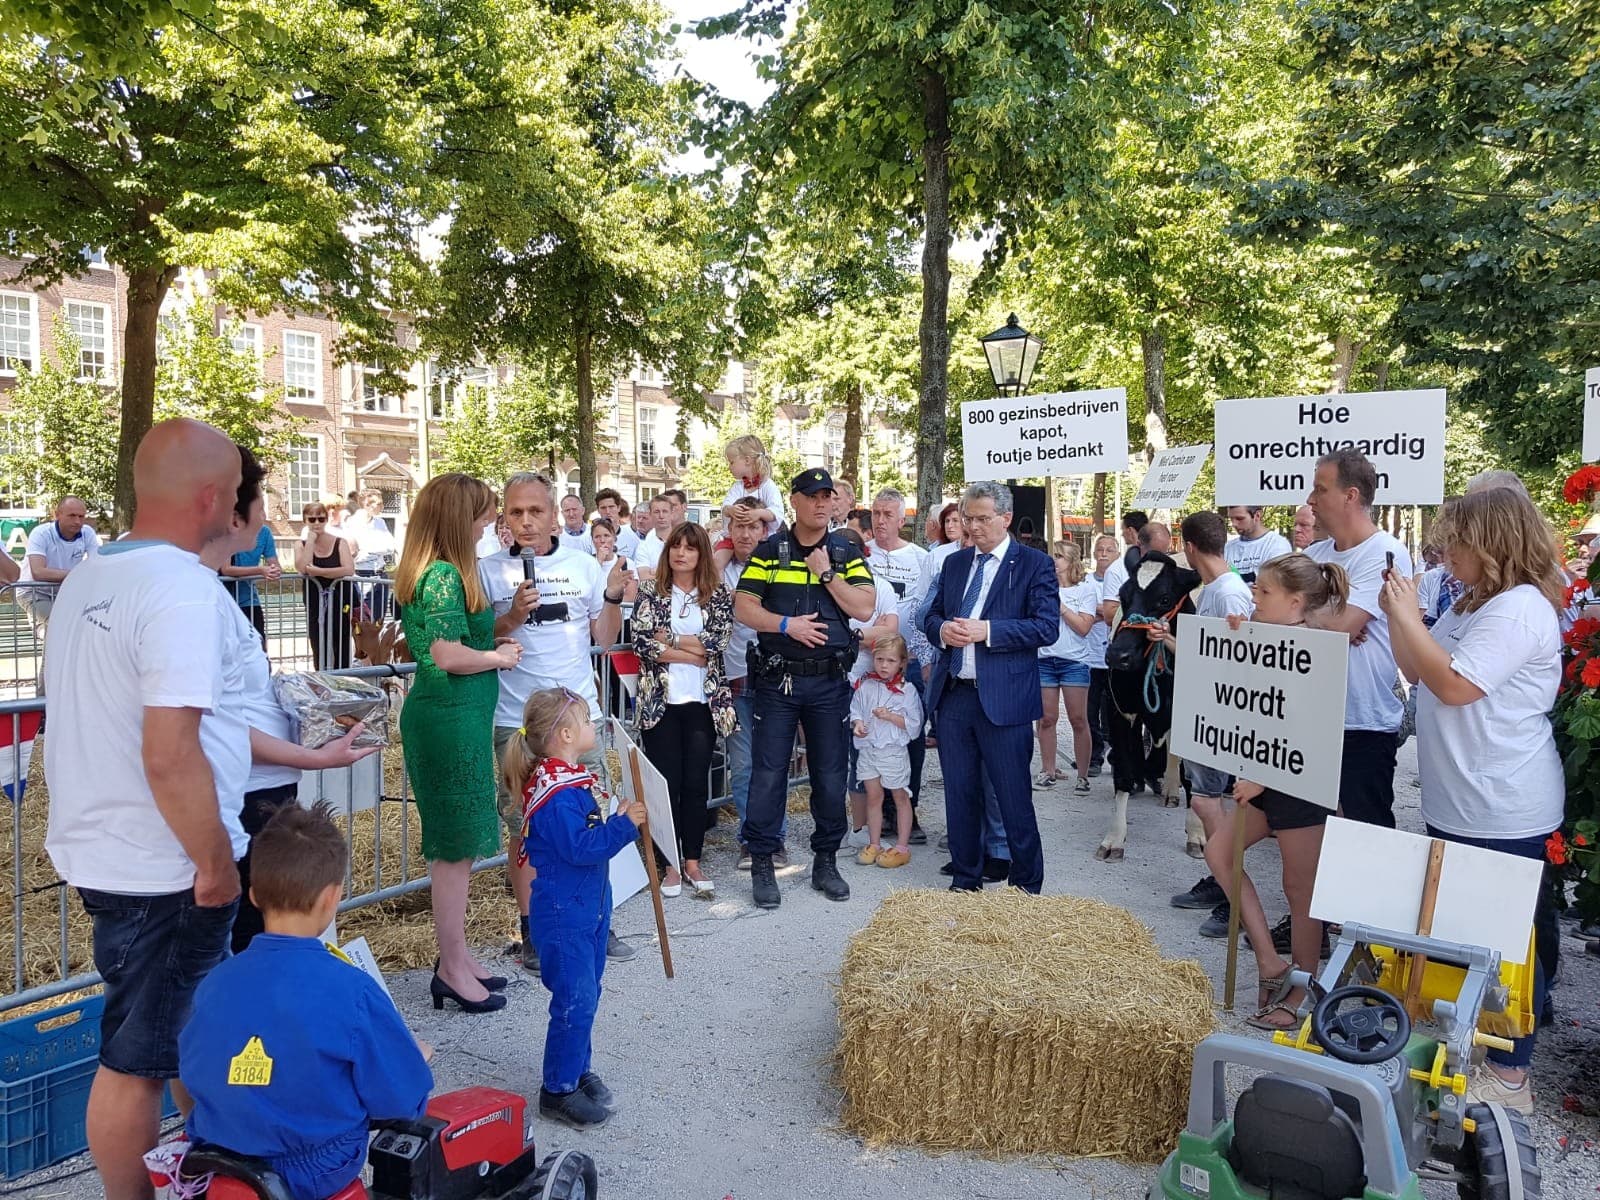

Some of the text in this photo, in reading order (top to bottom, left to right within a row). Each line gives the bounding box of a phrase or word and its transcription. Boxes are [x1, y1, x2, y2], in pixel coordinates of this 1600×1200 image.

[968, 400, 1119, 425] 800 gezinsbedrijven
[1298, 402, 1351, 425] Hoe
[1020, 424, 1067, 442] kapot,
[986, 442, 1104, 465] foutje bedankt
[1229, 432, 1426, 461] onrechtvaardig
[1259, 470, 1305, 491] kun
[1199, 627, 1312, 675] Innovatie
[1214, 681, 1286, 720] wordt
[1193, 714, 1305, 775] liquidatie
[234, 1066, 264, 1083] 3184
